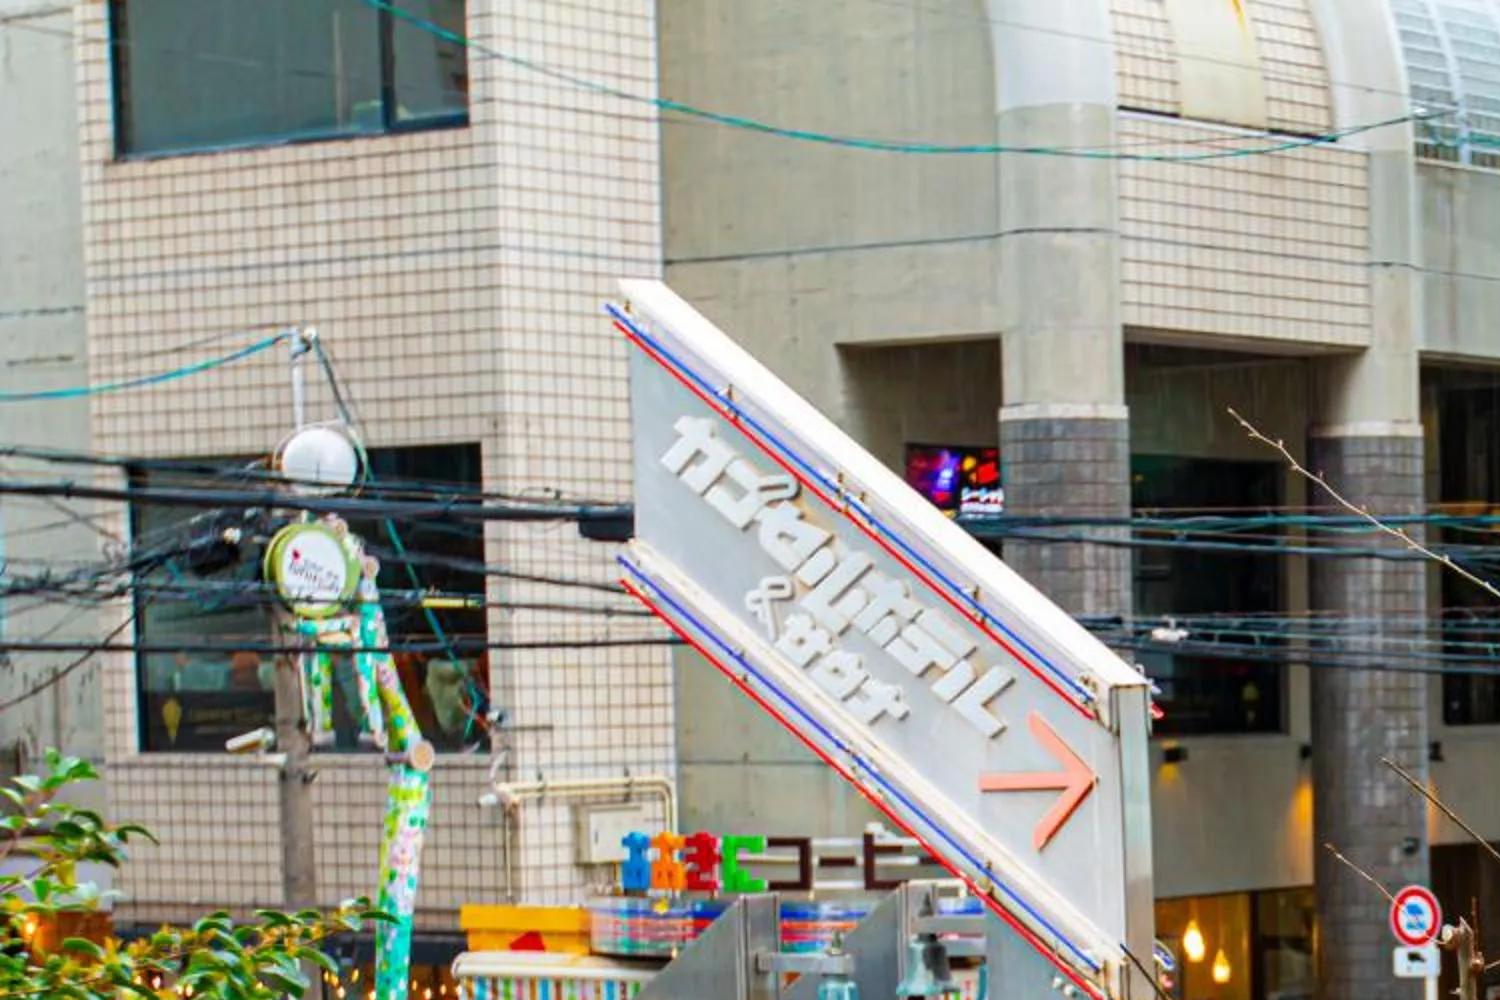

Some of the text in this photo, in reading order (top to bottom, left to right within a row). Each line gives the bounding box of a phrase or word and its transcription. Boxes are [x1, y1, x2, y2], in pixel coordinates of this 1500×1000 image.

[660, 415, 1016, 739] カプセルホテル
